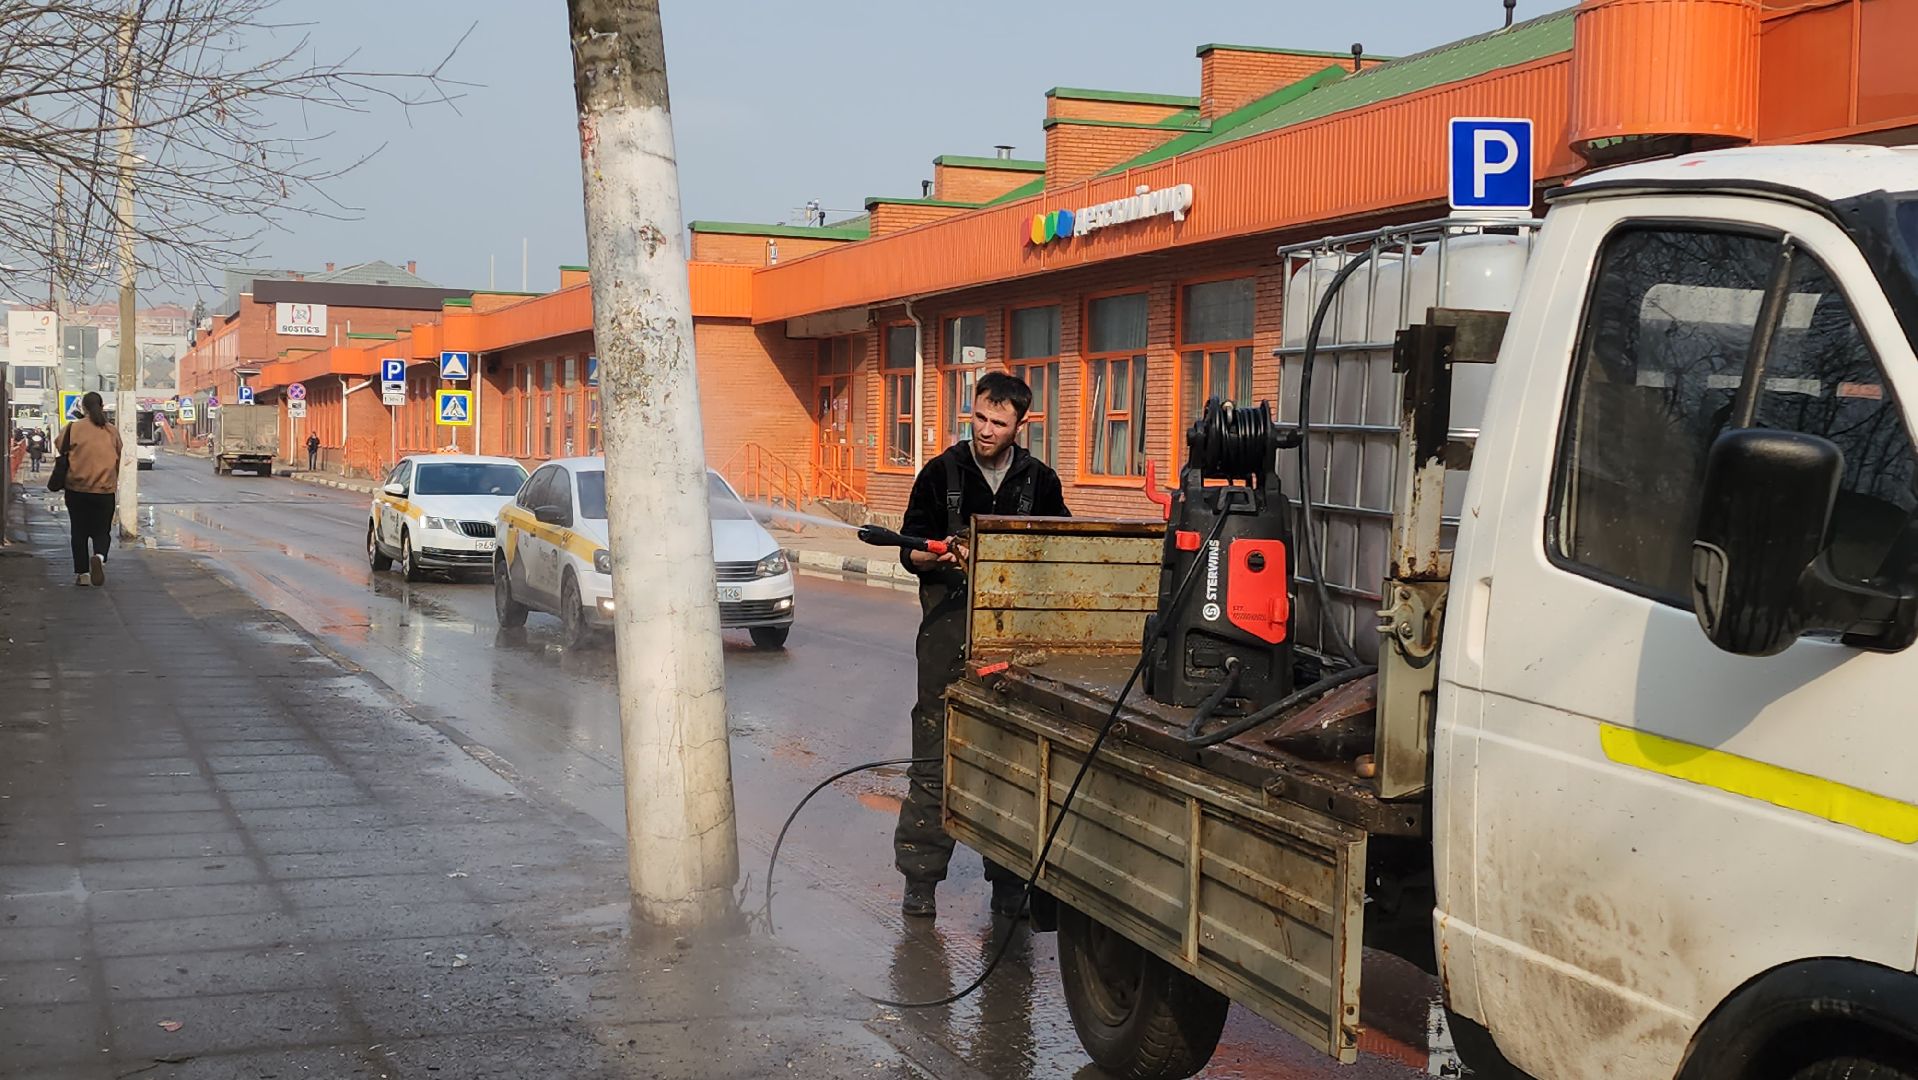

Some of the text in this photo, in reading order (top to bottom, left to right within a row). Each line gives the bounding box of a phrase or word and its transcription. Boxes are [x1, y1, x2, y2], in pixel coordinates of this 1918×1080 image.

[1474, 129, 1518, 198] P
[388, 361, 401, 379] P
[243, 389, 251, 399] P
[1206, 540, 1220, 600] STERWINS
